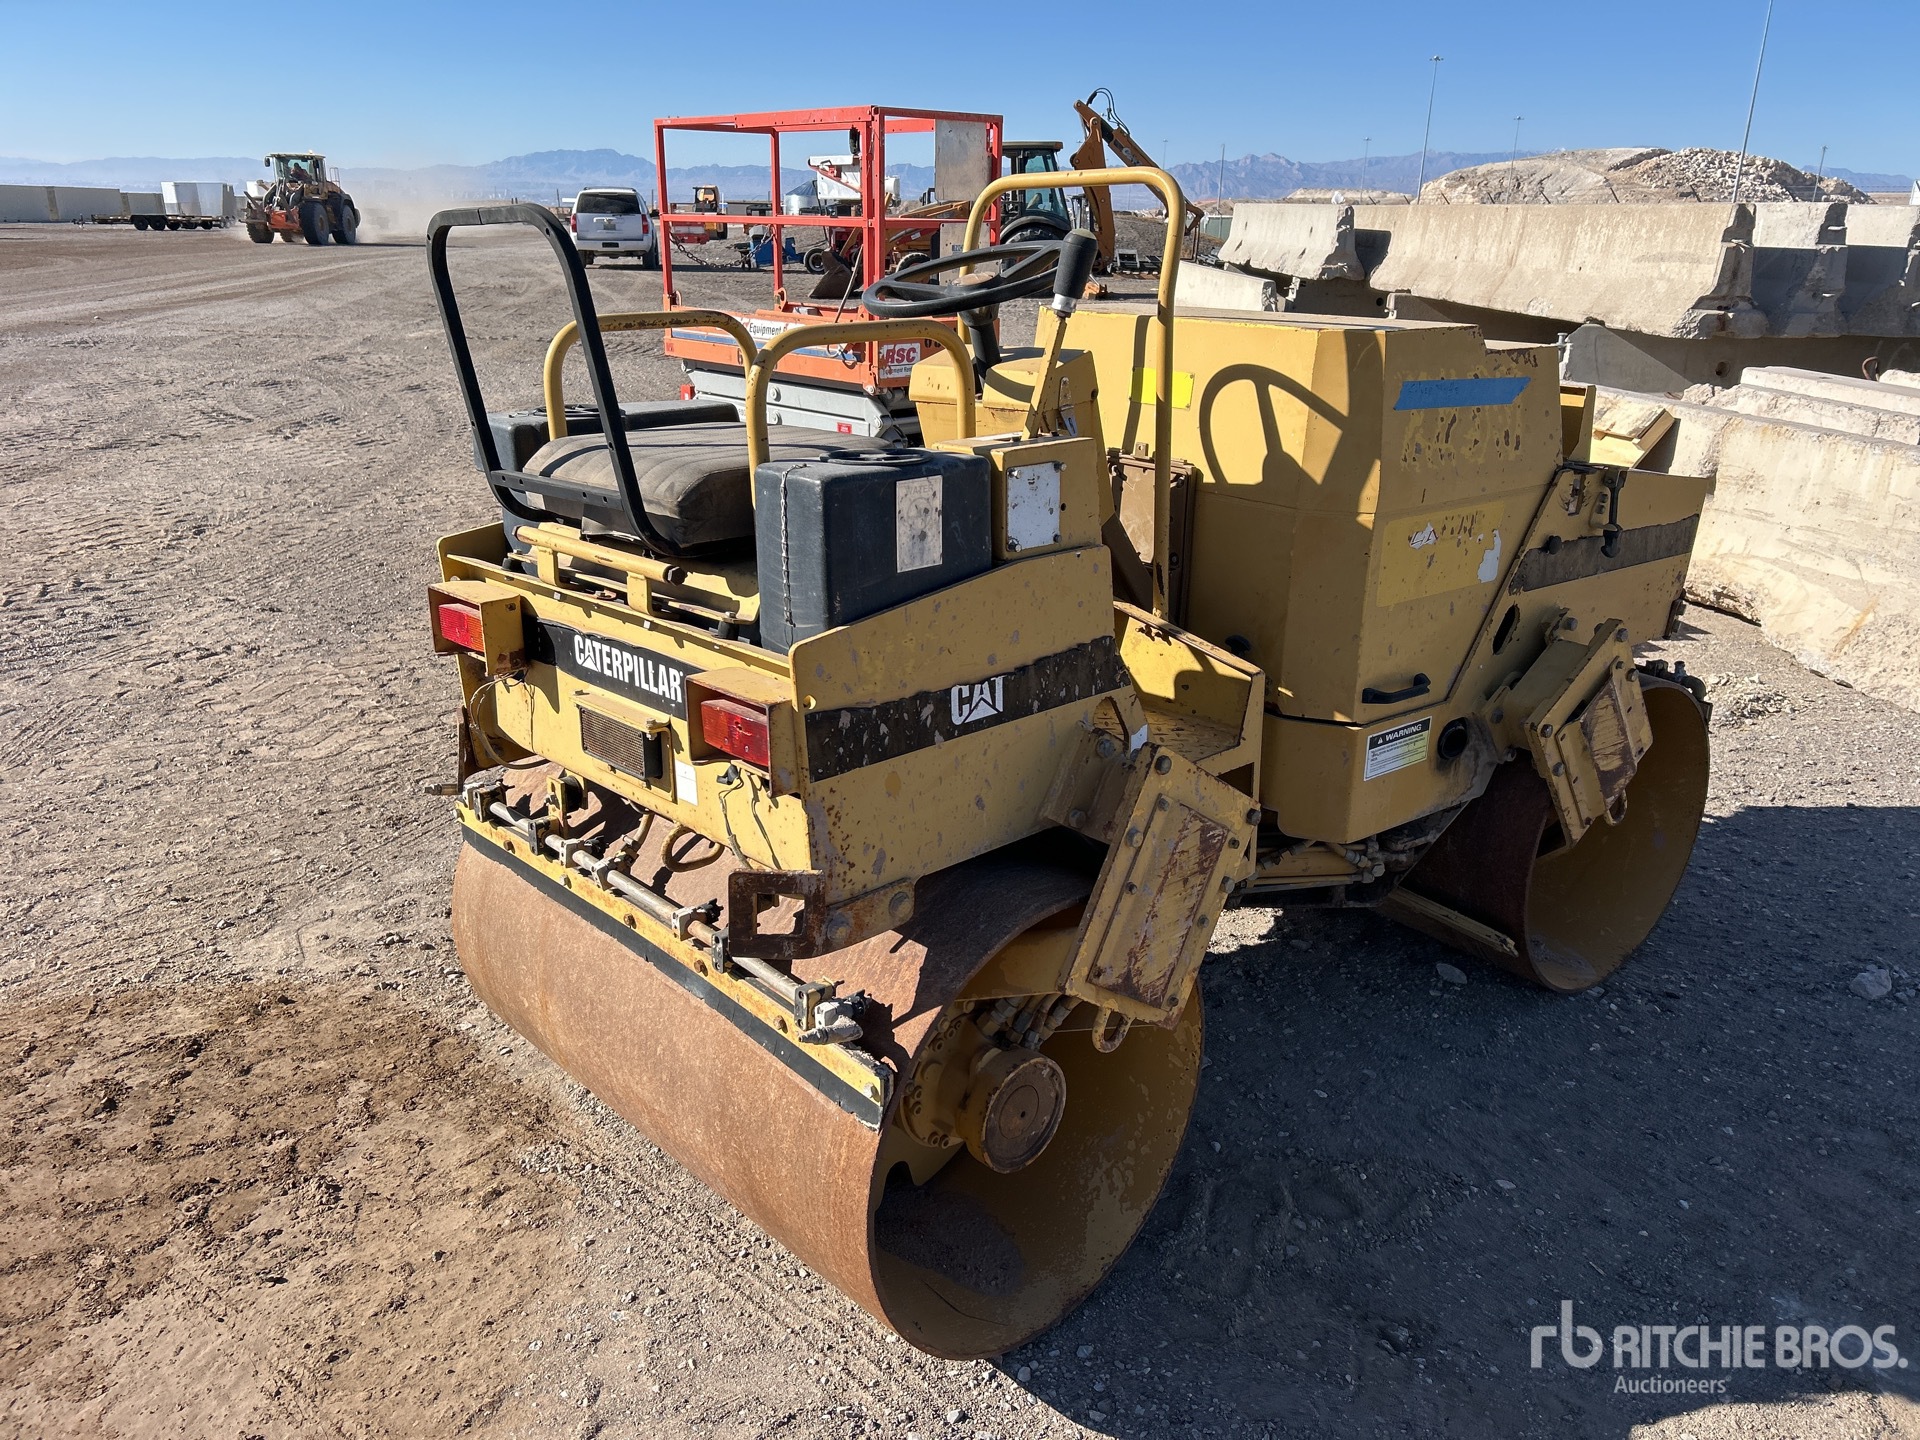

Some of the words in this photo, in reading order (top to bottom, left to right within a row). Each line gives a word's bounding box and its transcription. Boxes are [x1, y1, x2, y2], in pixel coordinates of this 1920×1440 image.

[749, 322, 782, 336] Equipment
[886, 347, 916, 364] RSC
[904, 484, 933, 495] WATER
[574, 635, 682, 703] CATERPILLAR
[951, 676, 1007, 725] CAT
[1385, 724, 1422, 741] WARNING
